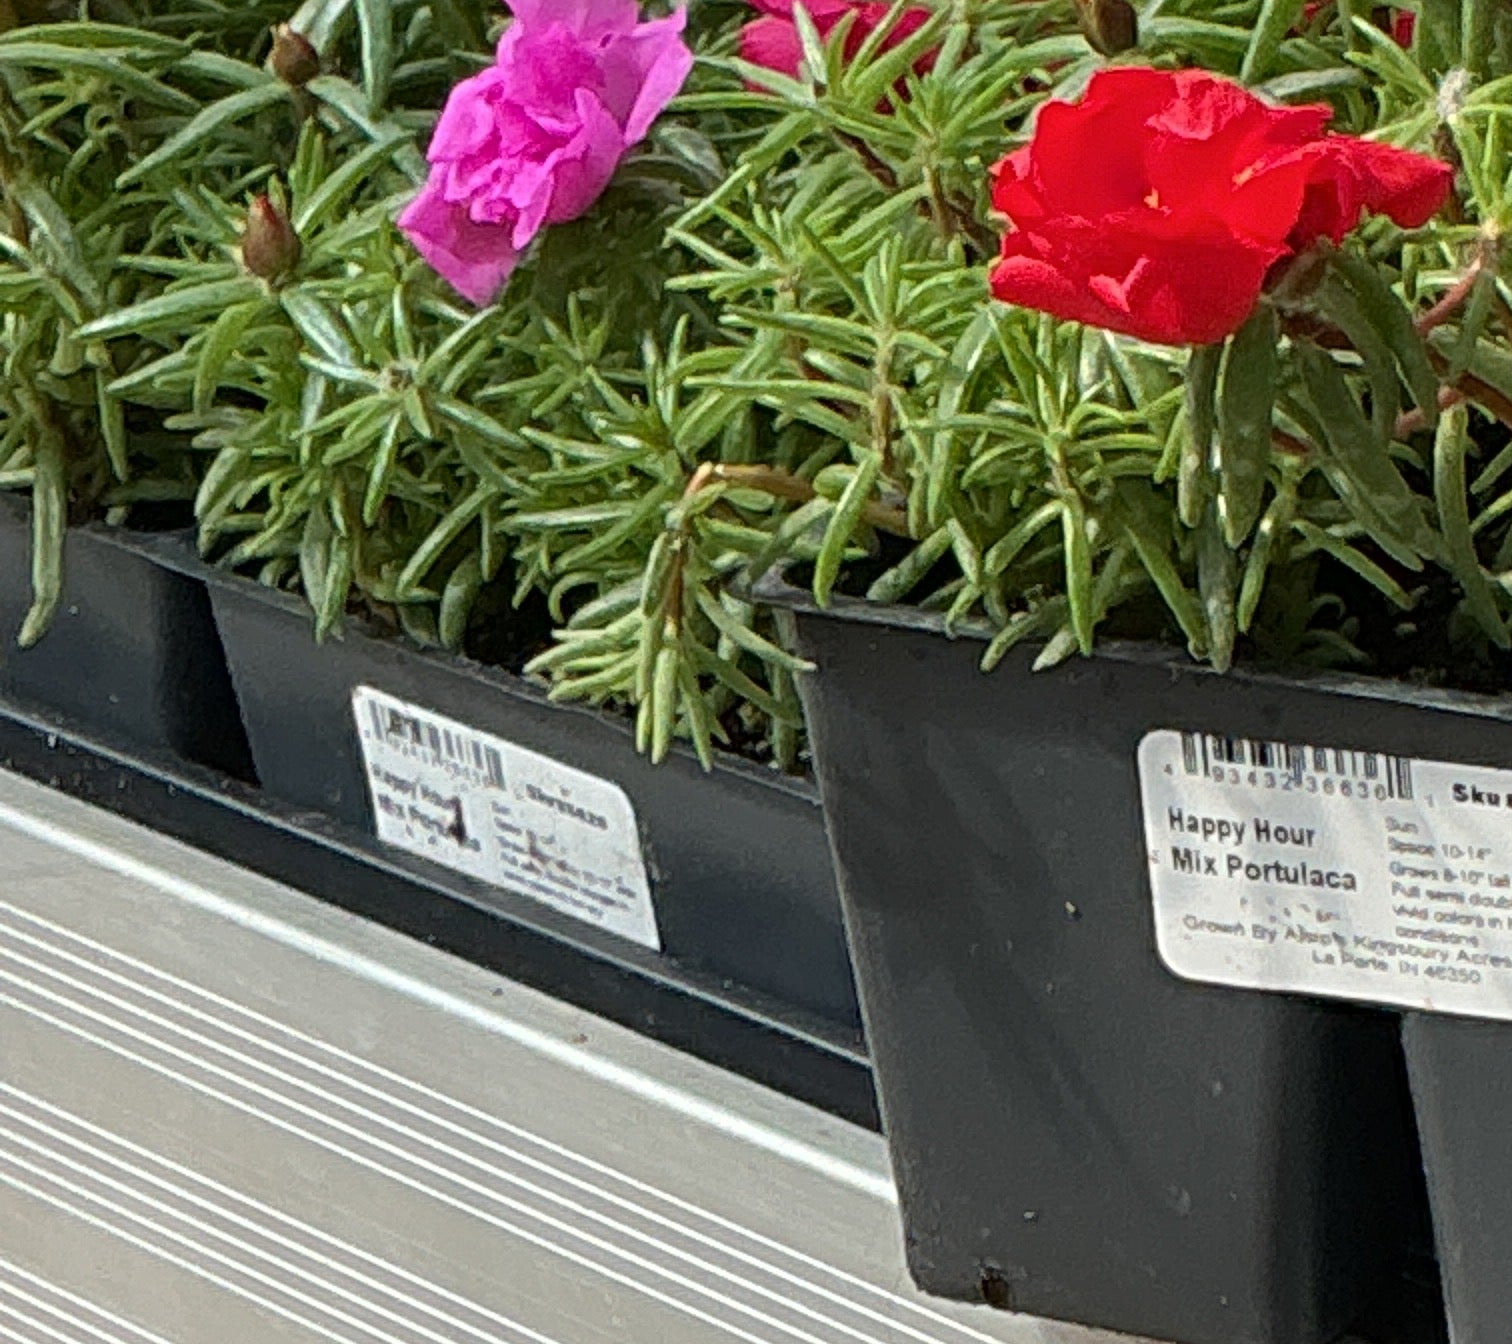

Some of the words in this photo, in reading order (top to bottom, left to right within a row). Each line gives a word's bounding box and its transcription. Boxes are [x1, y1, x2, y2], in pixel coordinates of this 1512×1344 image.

[1168, 806, 1246, 846] Happy
[1254, 818, 1316, 847] Hour
[1171, 846, 1218, 876] Mix
[1226, 854, 1357, 891] Portulaca
